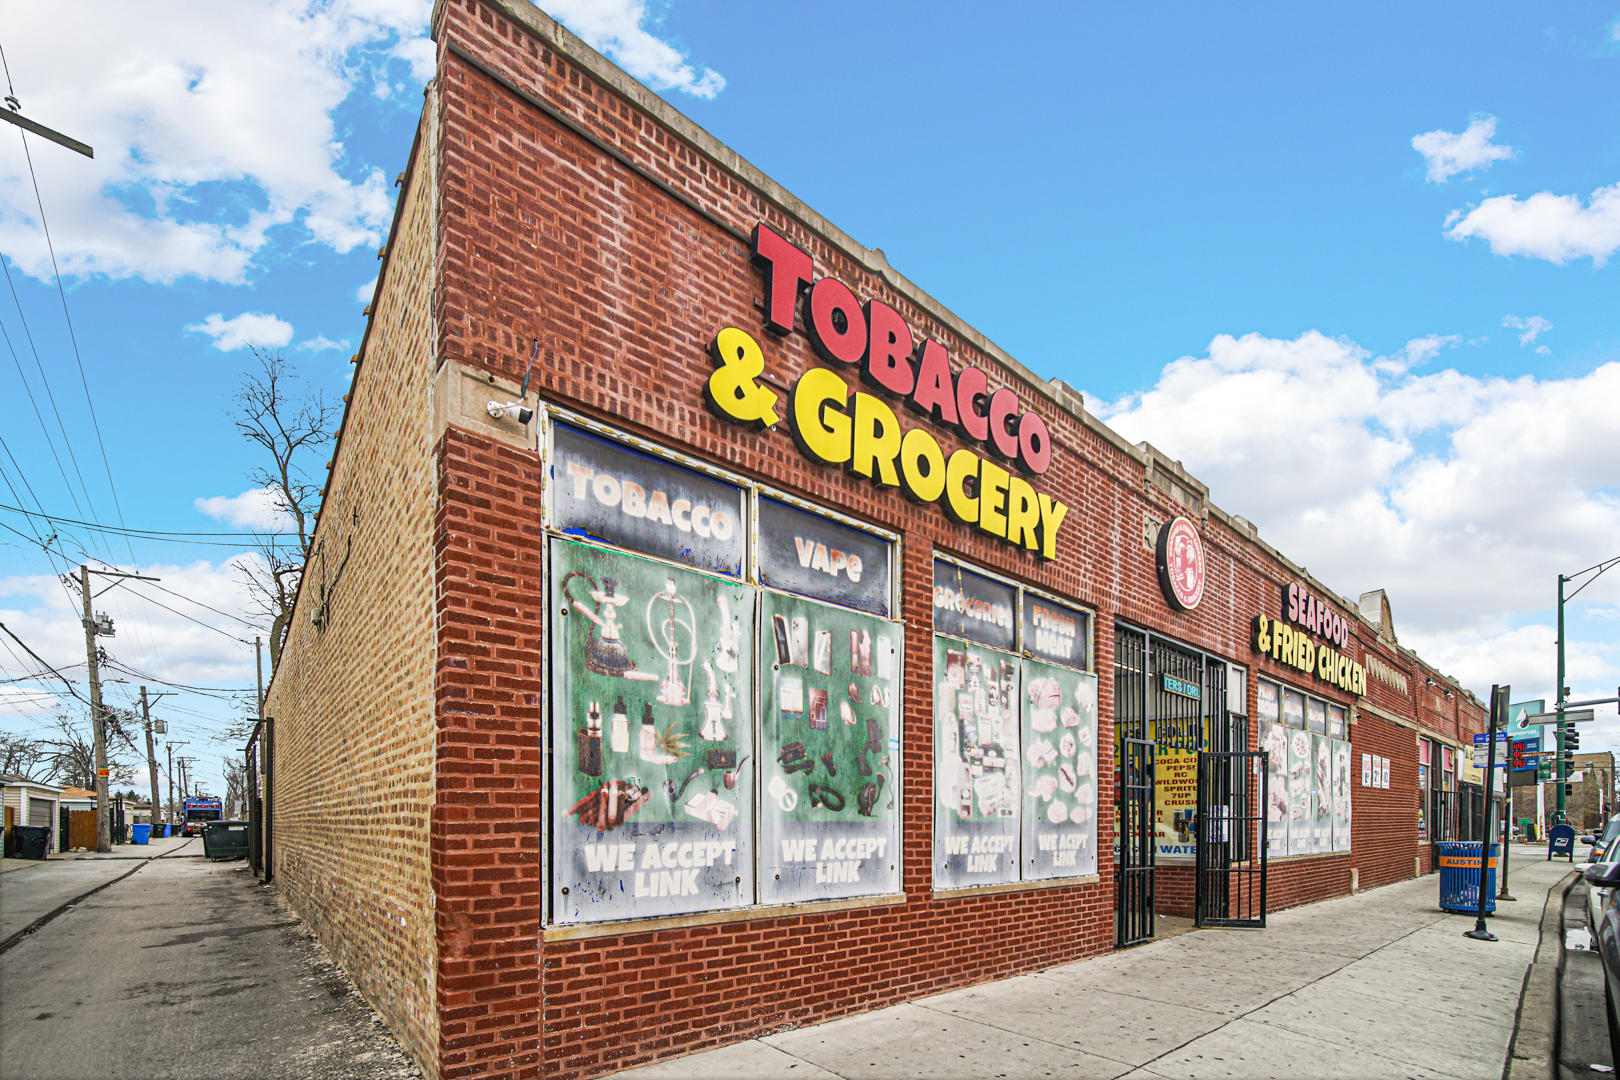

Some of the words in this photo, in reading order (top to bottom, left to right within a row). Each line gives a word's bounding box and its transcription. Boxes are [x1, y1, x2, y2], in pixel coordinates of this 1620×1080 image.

[752, 220, 1052, 475] TOBACCO
[705, 326, 780, 429] &
[789, 367, 1069, 562] GROCERY
[567, 461, 733, 541] TOBACCO
[1285, 582, 1350, 649] SEAFOOD
[1254, 614, 1272, 653] &
[1268, 619, 1316, 673] FRIED
[1315, 645, 1367, 697] CHICKEN
[584, 843, 637, 873] WE
[641, 840, 737, 869] ACCEPT
[781, 838, 817, 863] WE
[820, 837, 888, 861] ACCEPT
[944, 835, 970, 855] WE
[970, 835, 1015, 854] ACCEPT
[1038, 834, 1058, 851] WE
[1160, 845, 1198, 854] WATE
[815, 860, 861, 884] LINK
[966, 854, 998, 873] LINK
[1052, 850, 1077, 867] LINK
[635, 868, 701, 899] LINK
